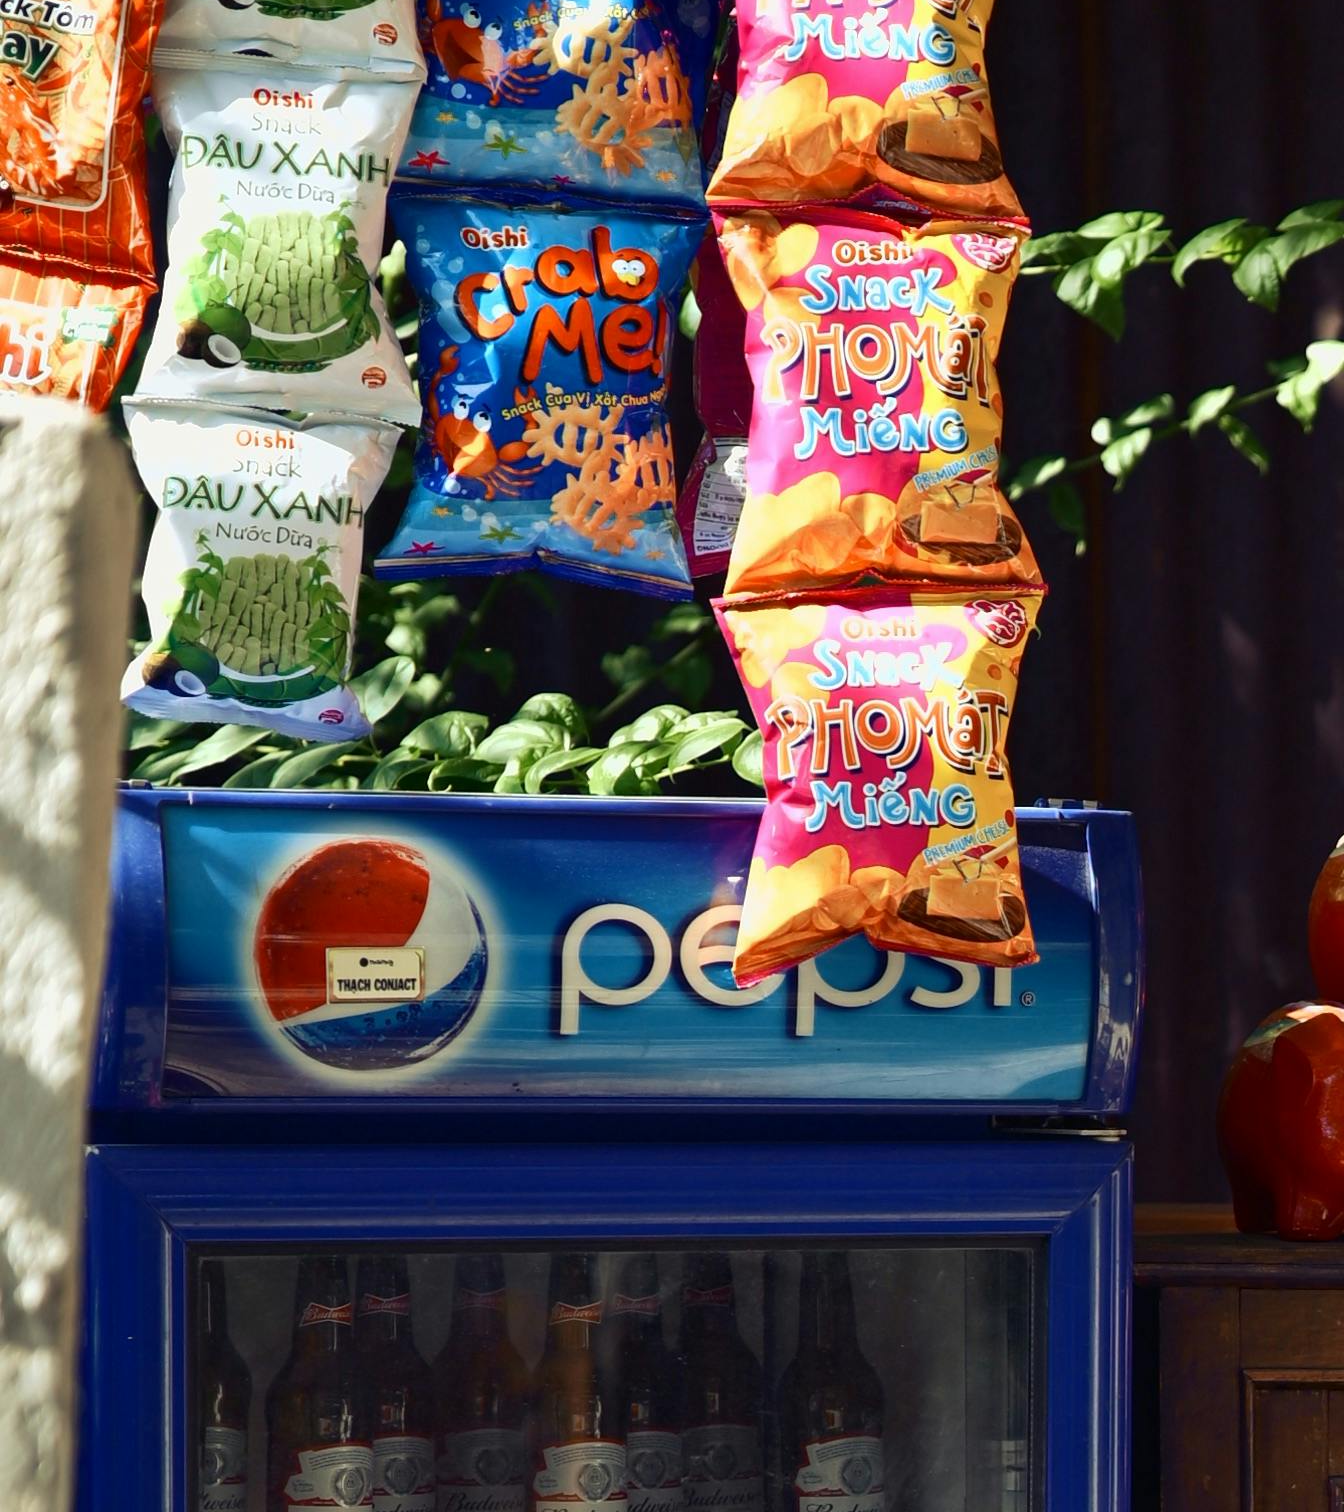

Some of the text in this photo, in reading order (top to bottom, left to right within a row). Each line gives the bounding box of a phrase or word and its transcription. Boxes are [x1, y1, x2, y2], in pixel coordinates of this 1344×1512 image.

[0, 28, 59, 80] ay
[253, 88, 314, 109] Oishi
[251, 113, 322, 136] Snack
[181, 133, 391, 188] ĐẬU XANH
[236, 180, 336, 204] Nước Dừa
[461, 226, 530, 250] Oishi
[454, 225, 660, 342] Crab
[521, 296, 669, 386] Me!
[501, 397, 543, 422] Snack
[544, 391, 573, 406] Cua
[621, 391, 649, 406] Chua
[236, 429, 296, 451] Oishi
[162, 475, 364, 530] ĐẬU XANH
[215, 521, 314, 550] Nước Dừa
